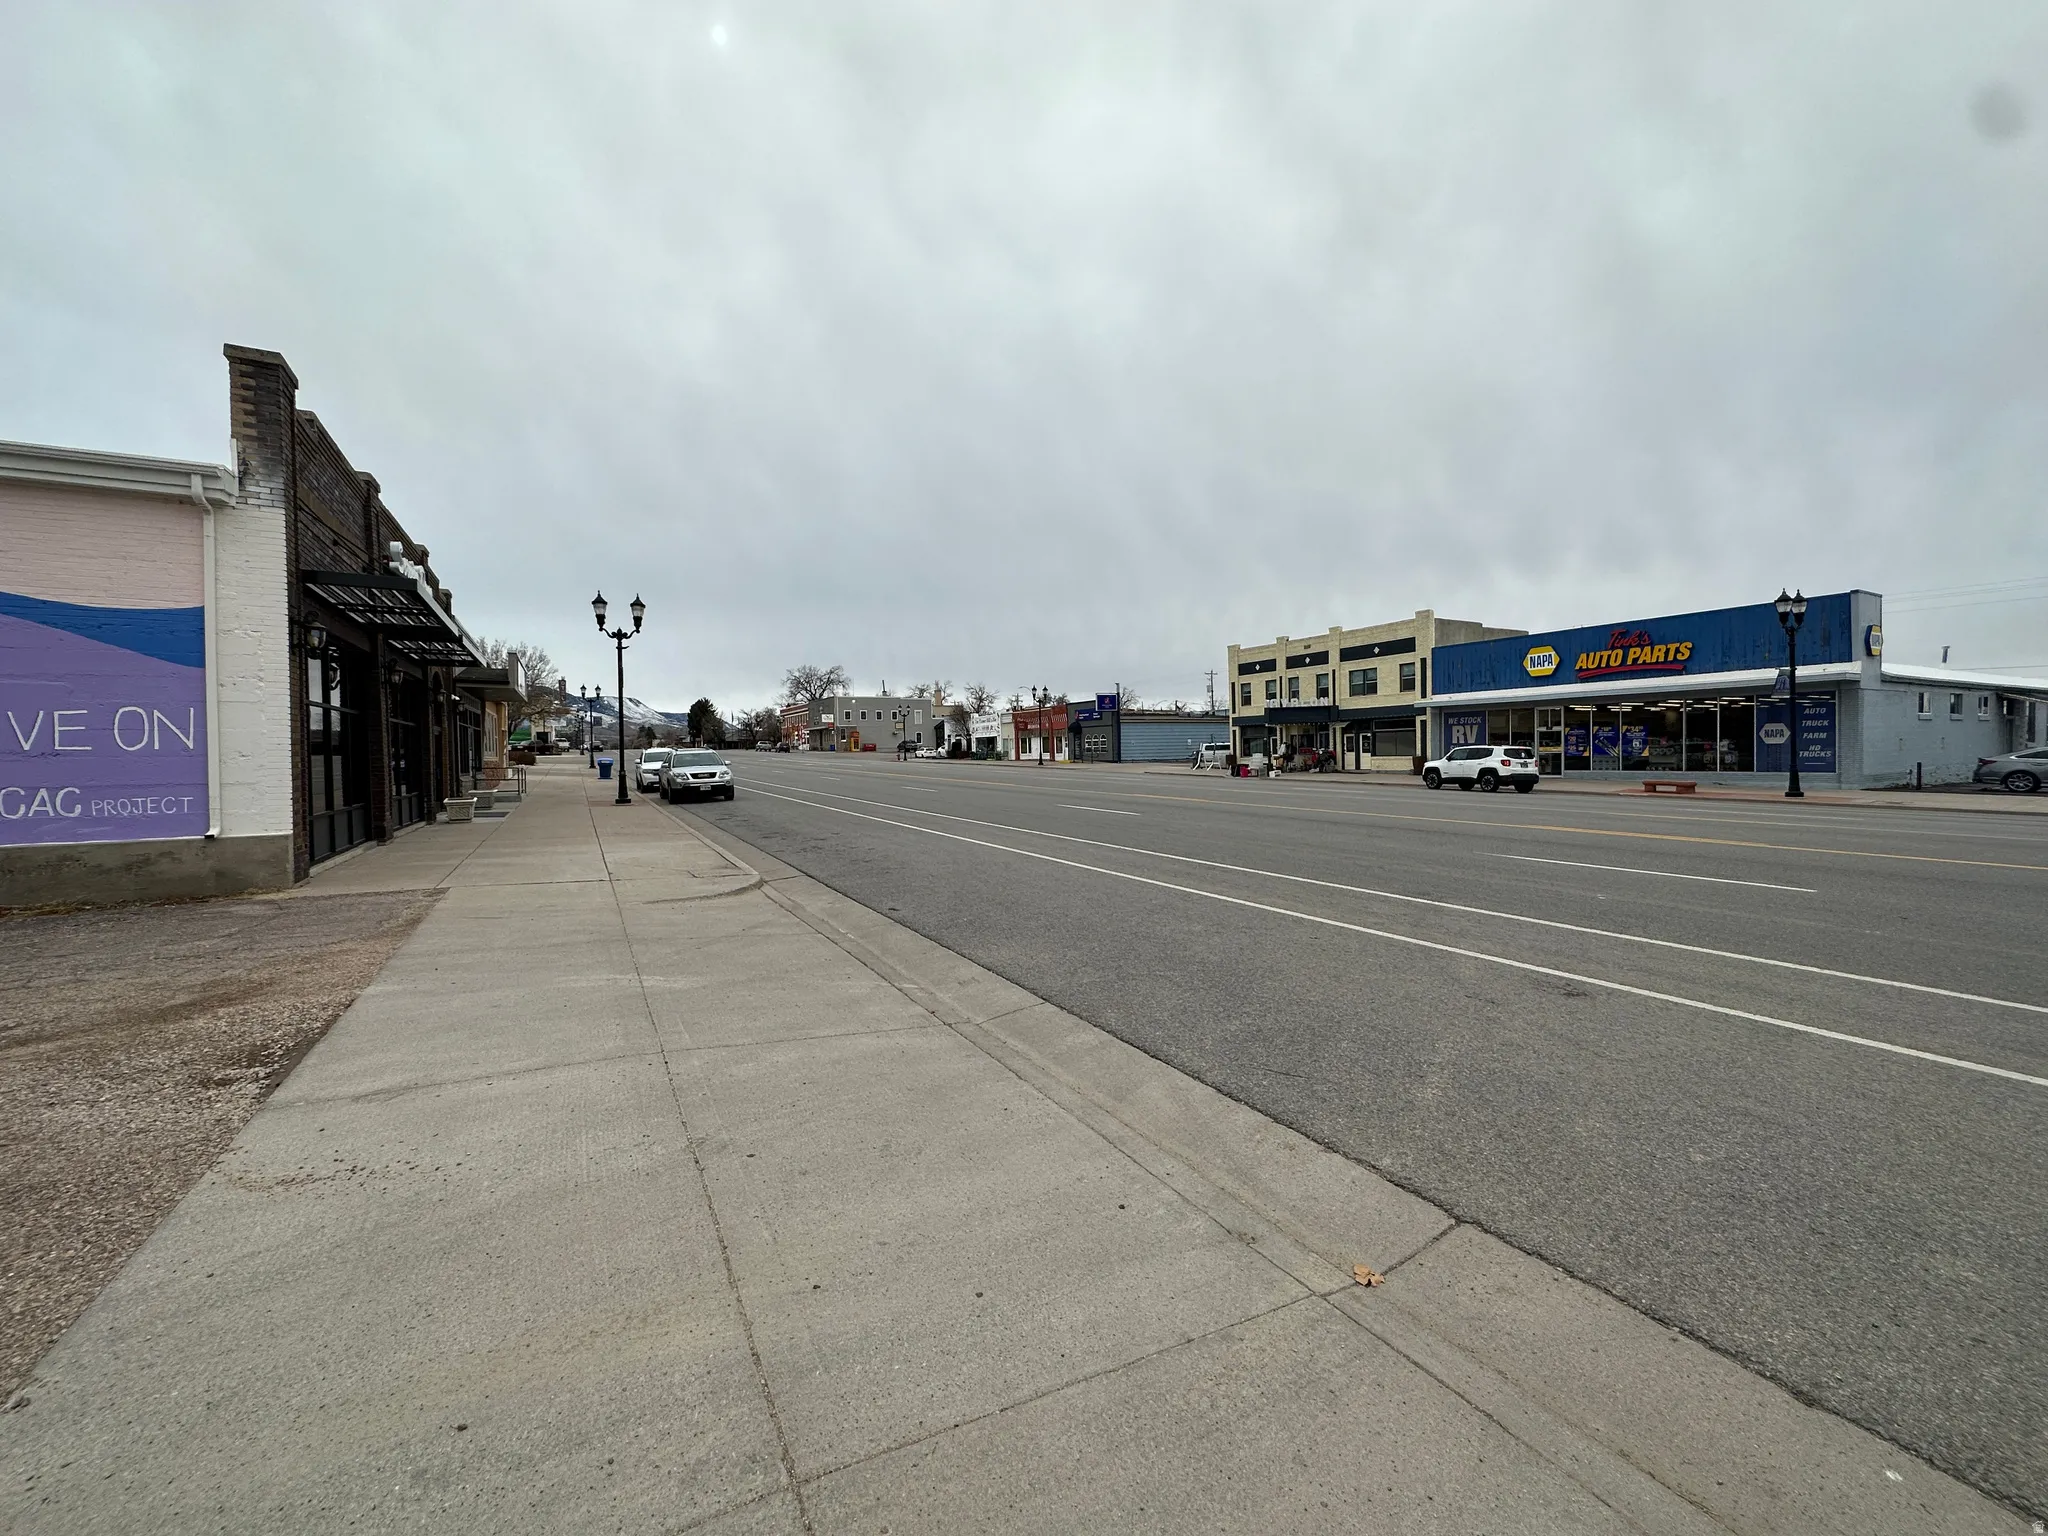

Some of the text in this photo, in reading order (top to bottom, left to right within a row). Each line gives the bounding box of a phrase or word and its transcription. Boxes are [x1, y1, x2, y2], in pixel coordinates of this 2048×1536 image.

[1529, 653, 1554, 669] NAPA
[1574, 641, 1693, 670] AUTO PARTS
[1803, 707, 1826, 715] AUTO
[1459, 716, 1483, 724] STOCK
[1801, 719, 1830, 727] TRUCK
[113, 706, 195, 751] ON
[1451, 724, 1479, 744] RV
[1763, 728, 1785, 738] NAPA
[1798, 750, 1832, 758] TRUCKS
[90, 796, 194, 817] PROJECT
